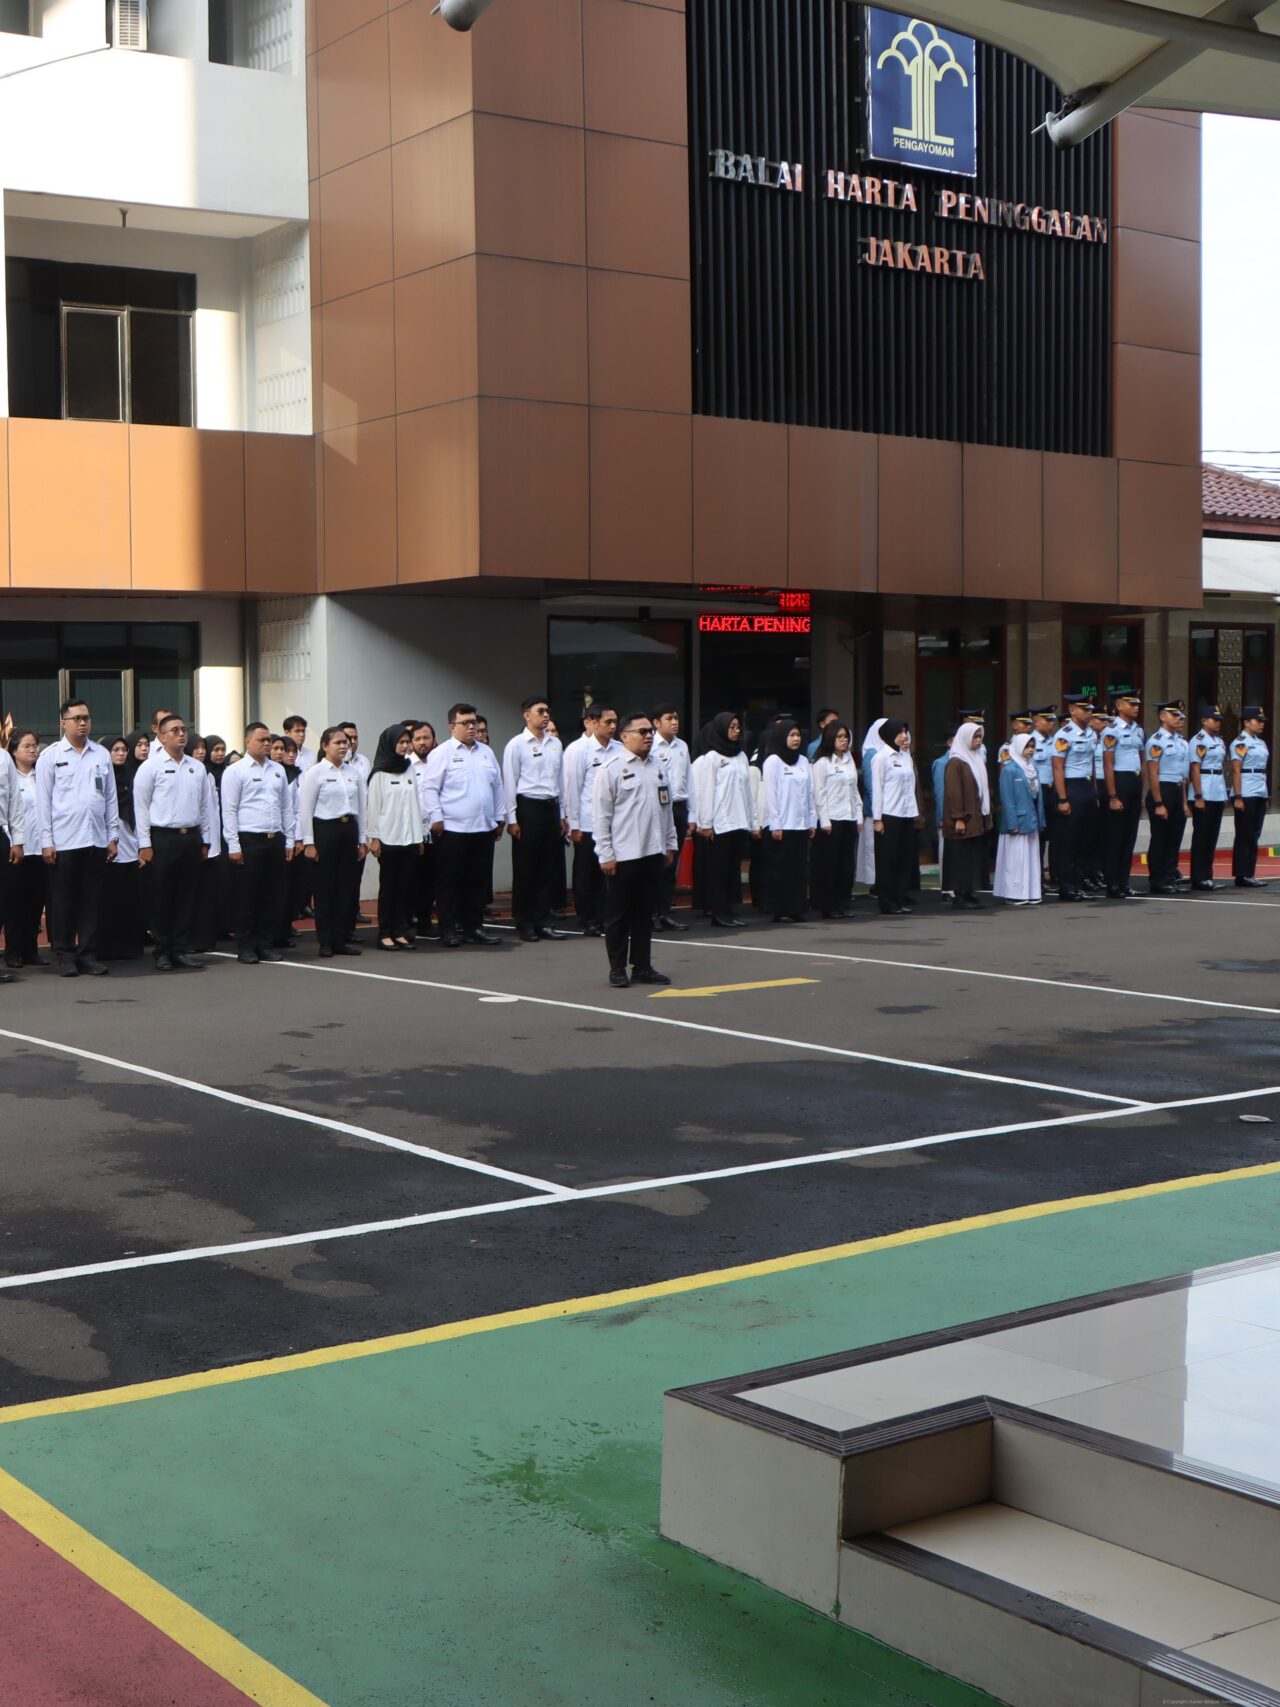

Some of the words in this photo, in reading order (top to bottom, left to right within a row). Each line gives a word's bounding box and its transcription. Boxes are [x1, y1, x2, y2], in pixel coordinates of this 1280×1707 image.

[893, 137, 955, 158] PENGAYOMAN
[714, 149, 803, 192] BALAI
[827, 169, 918, 212] HARTA
[939, 189, 1108, 244] PENINGGALAN
[863, 236, 985, 280] JAKARTA
[699, 617, 751, 632] HARTA
